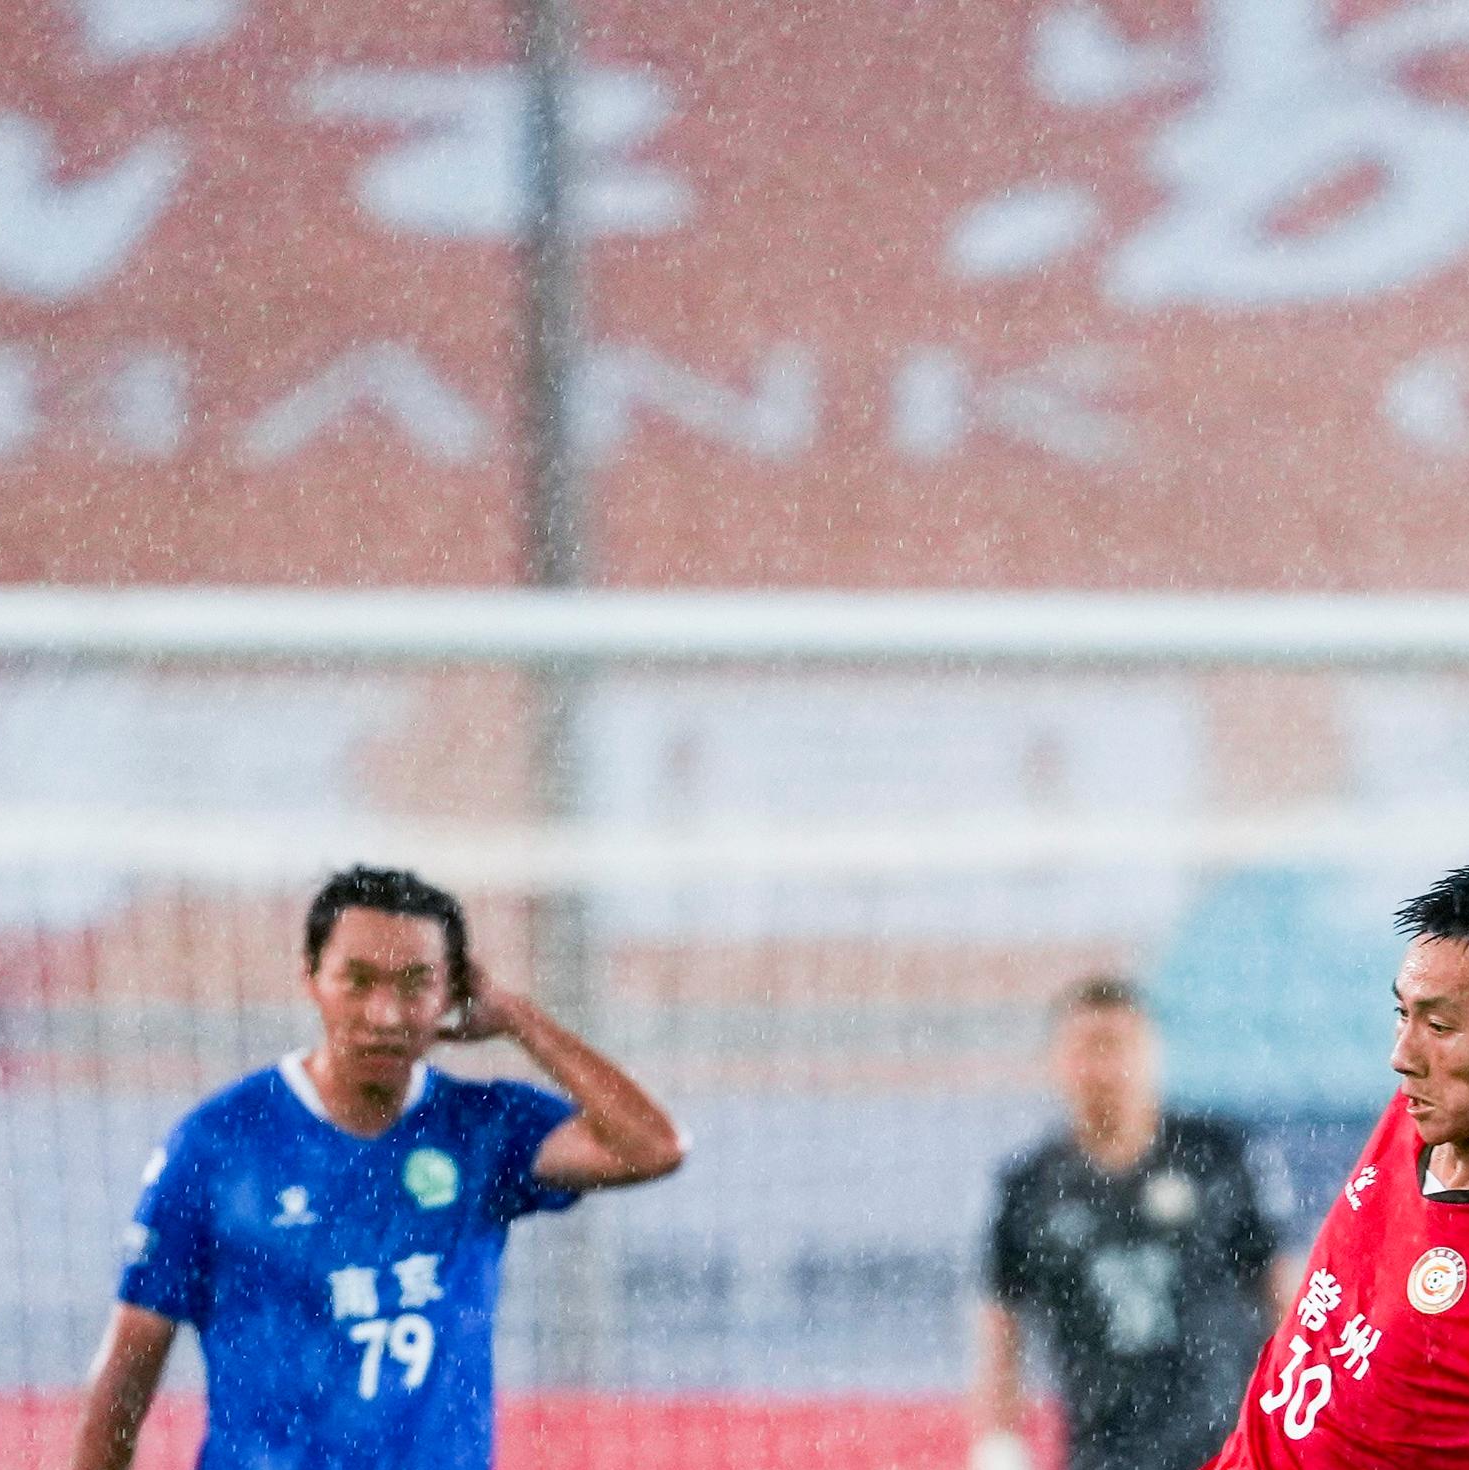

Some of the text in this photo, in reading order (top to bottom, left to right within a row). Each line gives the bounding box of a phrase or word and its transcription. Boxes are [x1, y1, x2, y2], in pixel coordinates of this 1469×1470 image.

[328, 1252, 444, 1320] 南京
[1297, 1268, 1382, 1380] 常州
[348, 1313, 435, 1400] 79
[1259, 1334, 1332, 1440] 30
